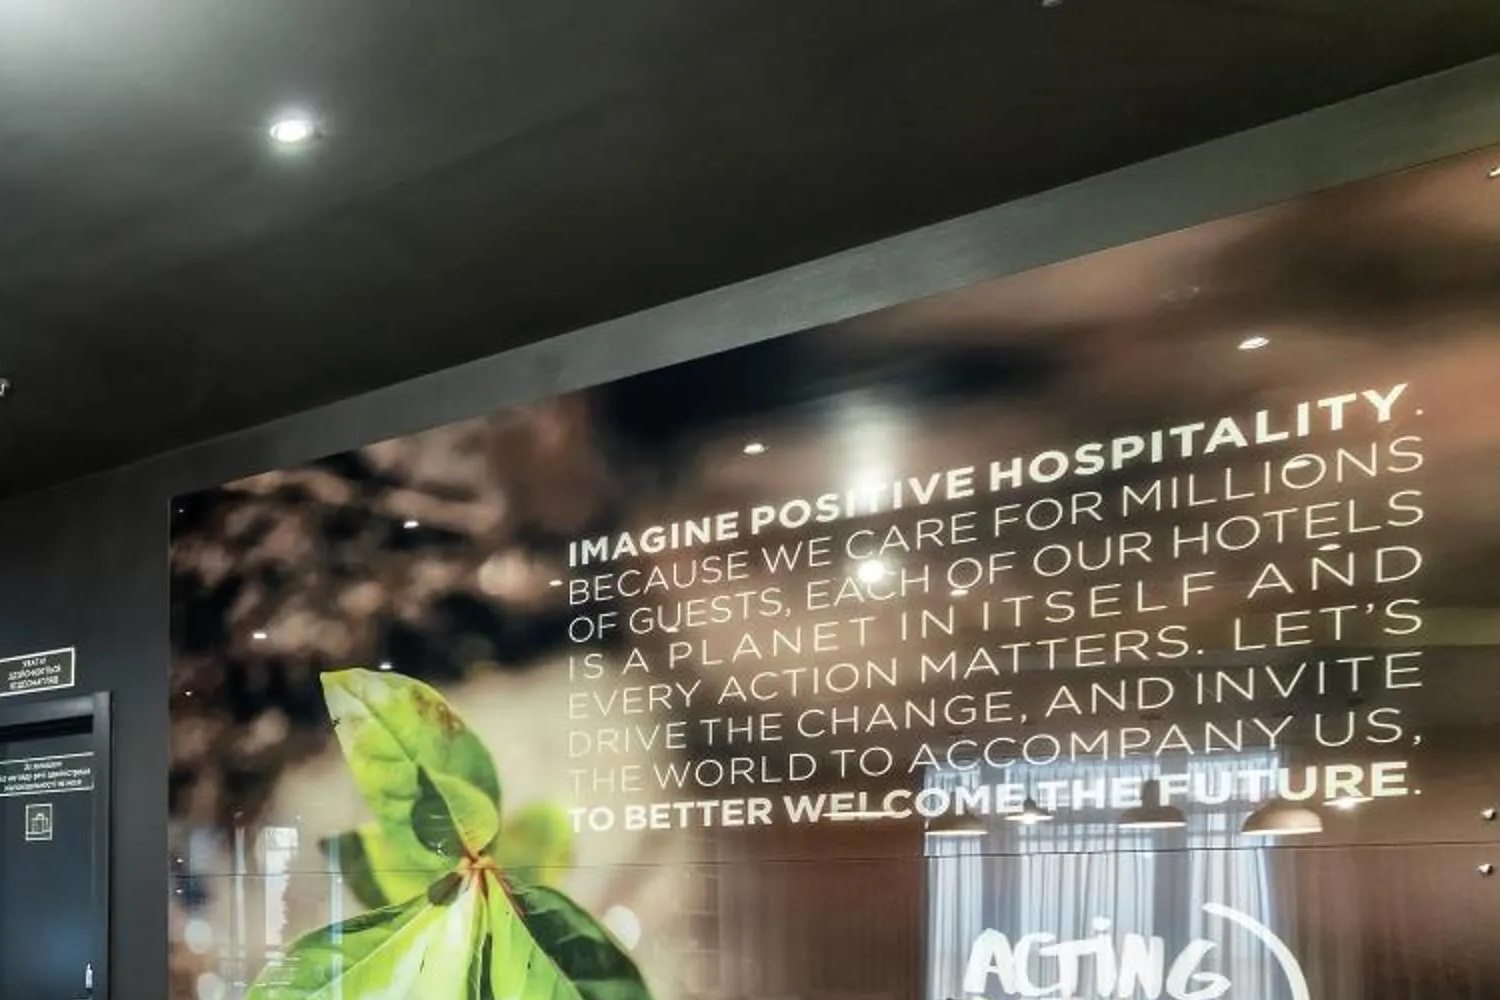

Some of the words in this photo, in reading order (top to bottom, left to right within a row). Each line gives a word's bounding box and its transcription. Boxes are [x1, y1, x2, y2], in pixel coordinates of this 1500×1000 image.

[569, 511, 739, 568] IMAGINE
[751, 466, 975, 536] POSITIVE
[989, 383, 1424, 492] HOSPITALITY.
[569, 551, 749, 606] BECAUSE
[761, 536, 832, 574] WE
[845, 511, 978, 561] CARE
[994, 491, 1104, 538] FOR
[1123, 436, 1424, 517] MILLIONS
[568, 611, 618, 643] OF
[629, 587, 792, 635] GUESTS,
[807, 564, 930, 611] EACH
[947, 551, 1017, 590] OF
[1033, 531, 1153, 578] OUR
[1173, 490, 1424, 559] HOTELS
[569, 653, 605, 681] IS
[622, 647, 650, 676] A
[669, 615, 877, 670] PLANET
[901, 604, 955, 641] IN
[983, 571, 1216, 632] ITSELF
[1247, 545, 1423, 600] AND
[569, 679, 702, 720] EVERY
[717, 657, 898, 705] ACTION
[920, 625, 1205, 684] MATTERS.
[569, 721, 688, 759] DRIVE
[700, 712, 785, 747] THE
[797, 691, 1029, 739] CHANGE,
[1045, 676, 1175, 719] AND
[1197, 651, 1423, 705] INVITE
[568, 806, 616, 834] TO
[624, 797, 773, 831] BETTER
[783, 783, 1025, 823] WELCOME
[1036, 775, 1142, 811] THE
[1158, 761, 1422, 808] FUTURE.
[569, 764, 644, 796] THE
[653, 753, 817, 791] WORLD
[830, 746, 893, 779] TO
[908, 715, 1295, 774] ACCOMPANY
[1315, 707, 1423, 747] US,
